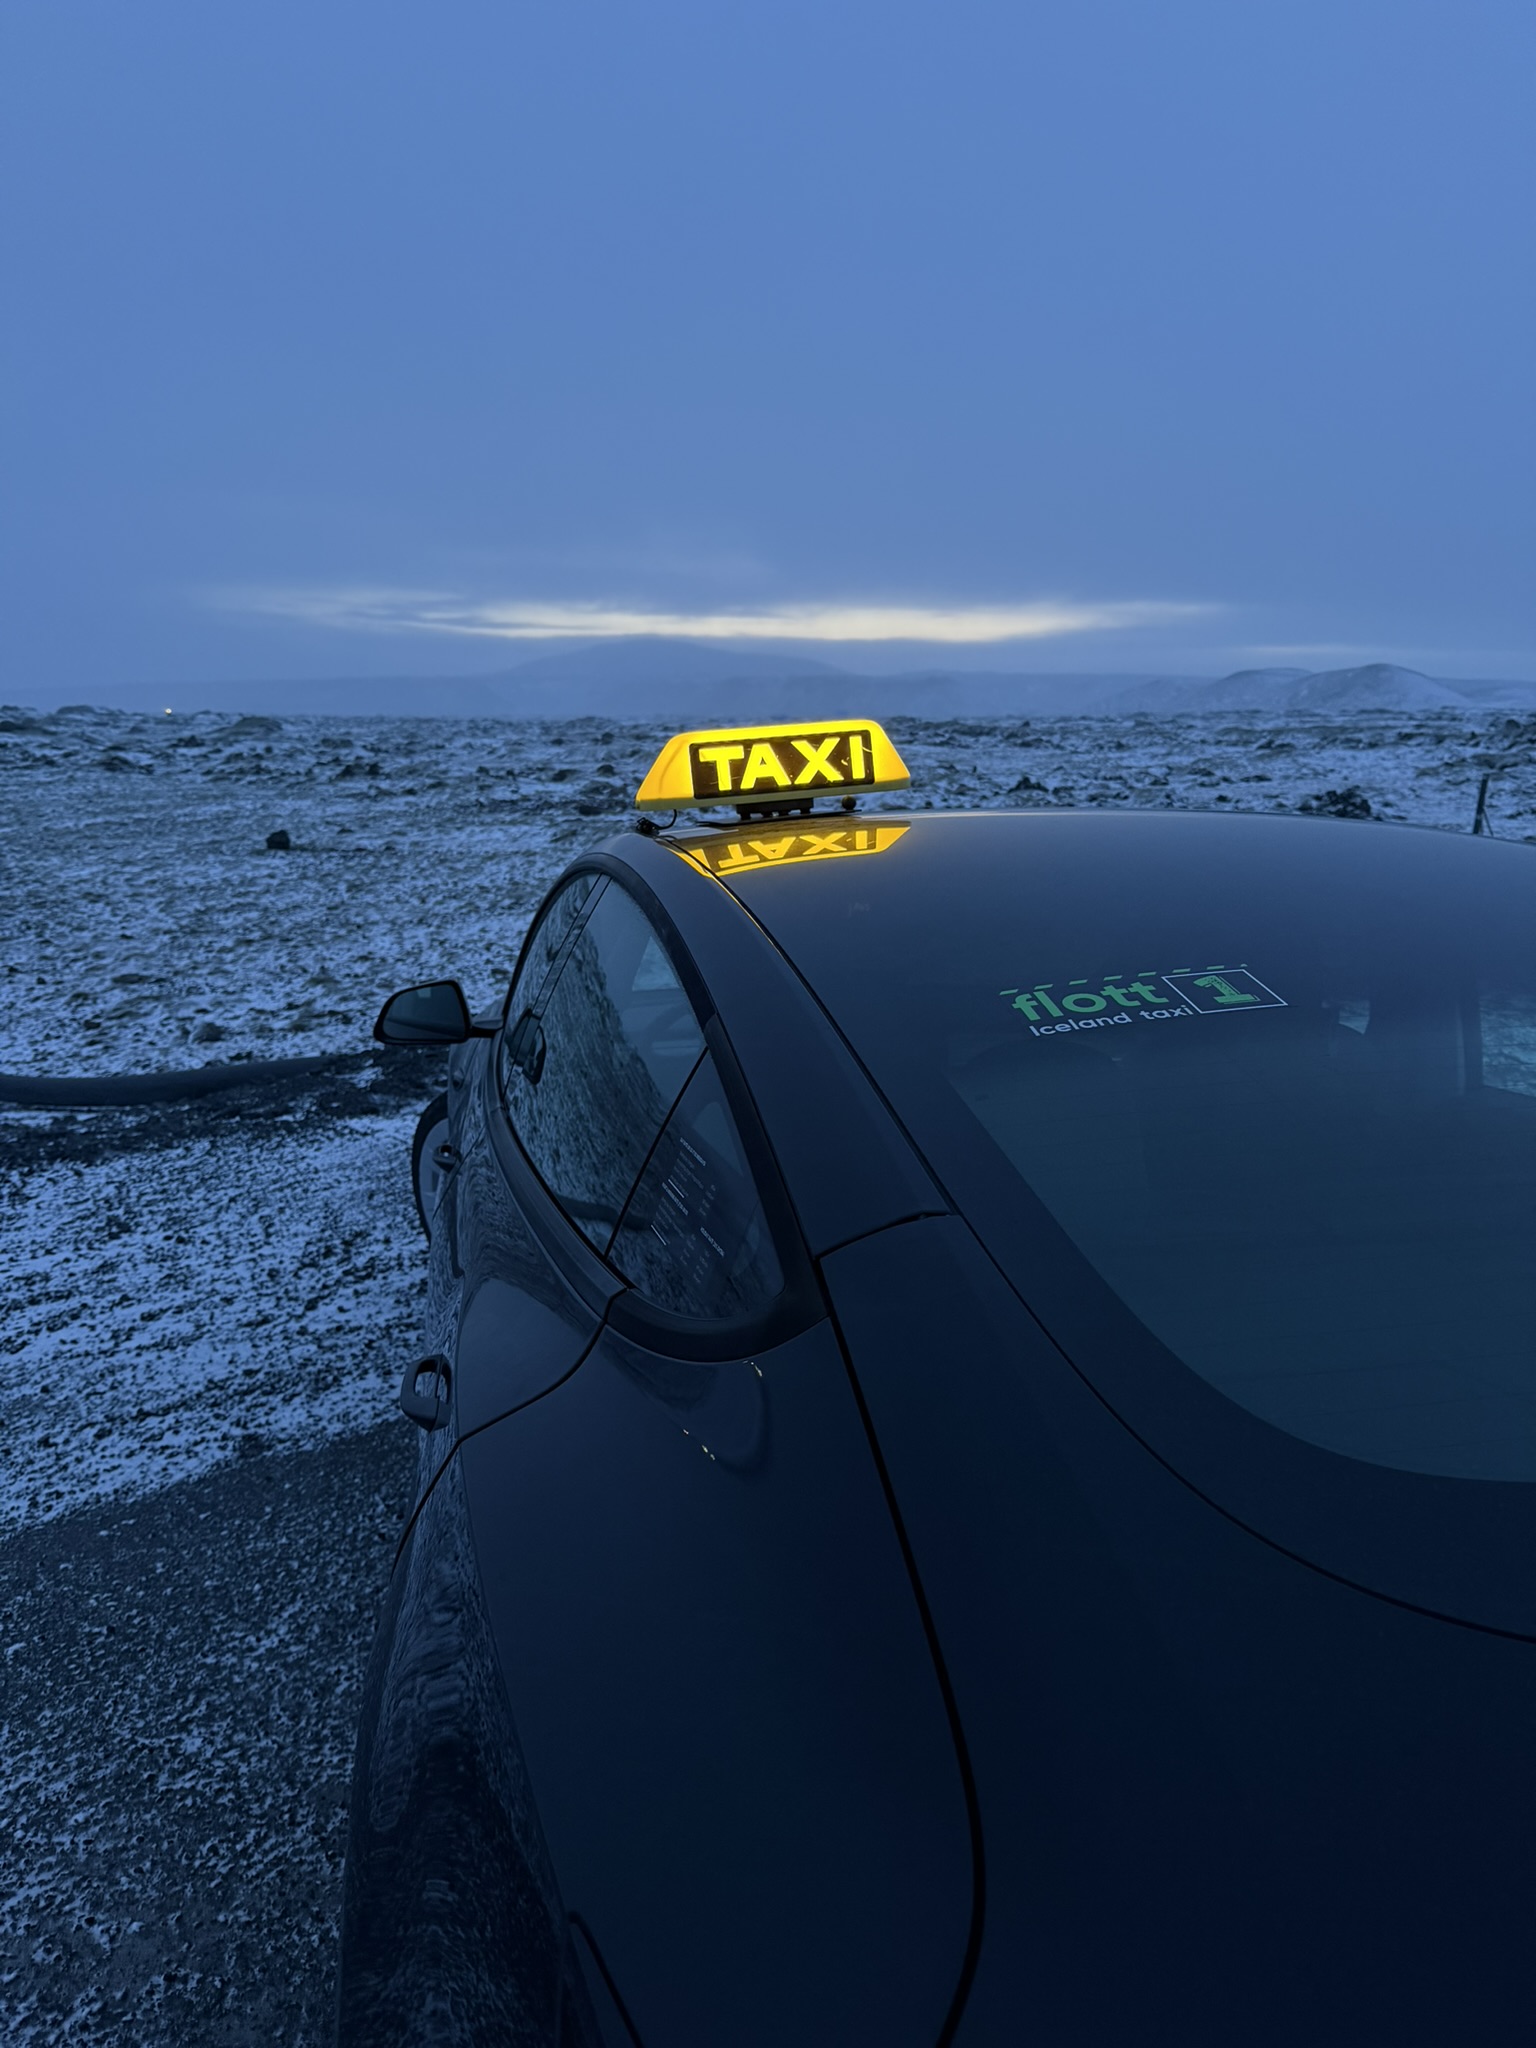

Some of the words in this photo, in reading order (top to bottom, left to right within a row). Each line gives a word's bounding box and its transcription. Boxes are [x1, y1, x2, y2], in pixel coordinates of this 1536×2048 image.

[699, 736, 865, 791] TAXI
[1011, 981, 1169, 1021] flott
[1193, 975, 1261, 1004] 1
[1029, 1012, 1132, 1036] Iceland
[1139, 1005, 1194, 1020] taxi
